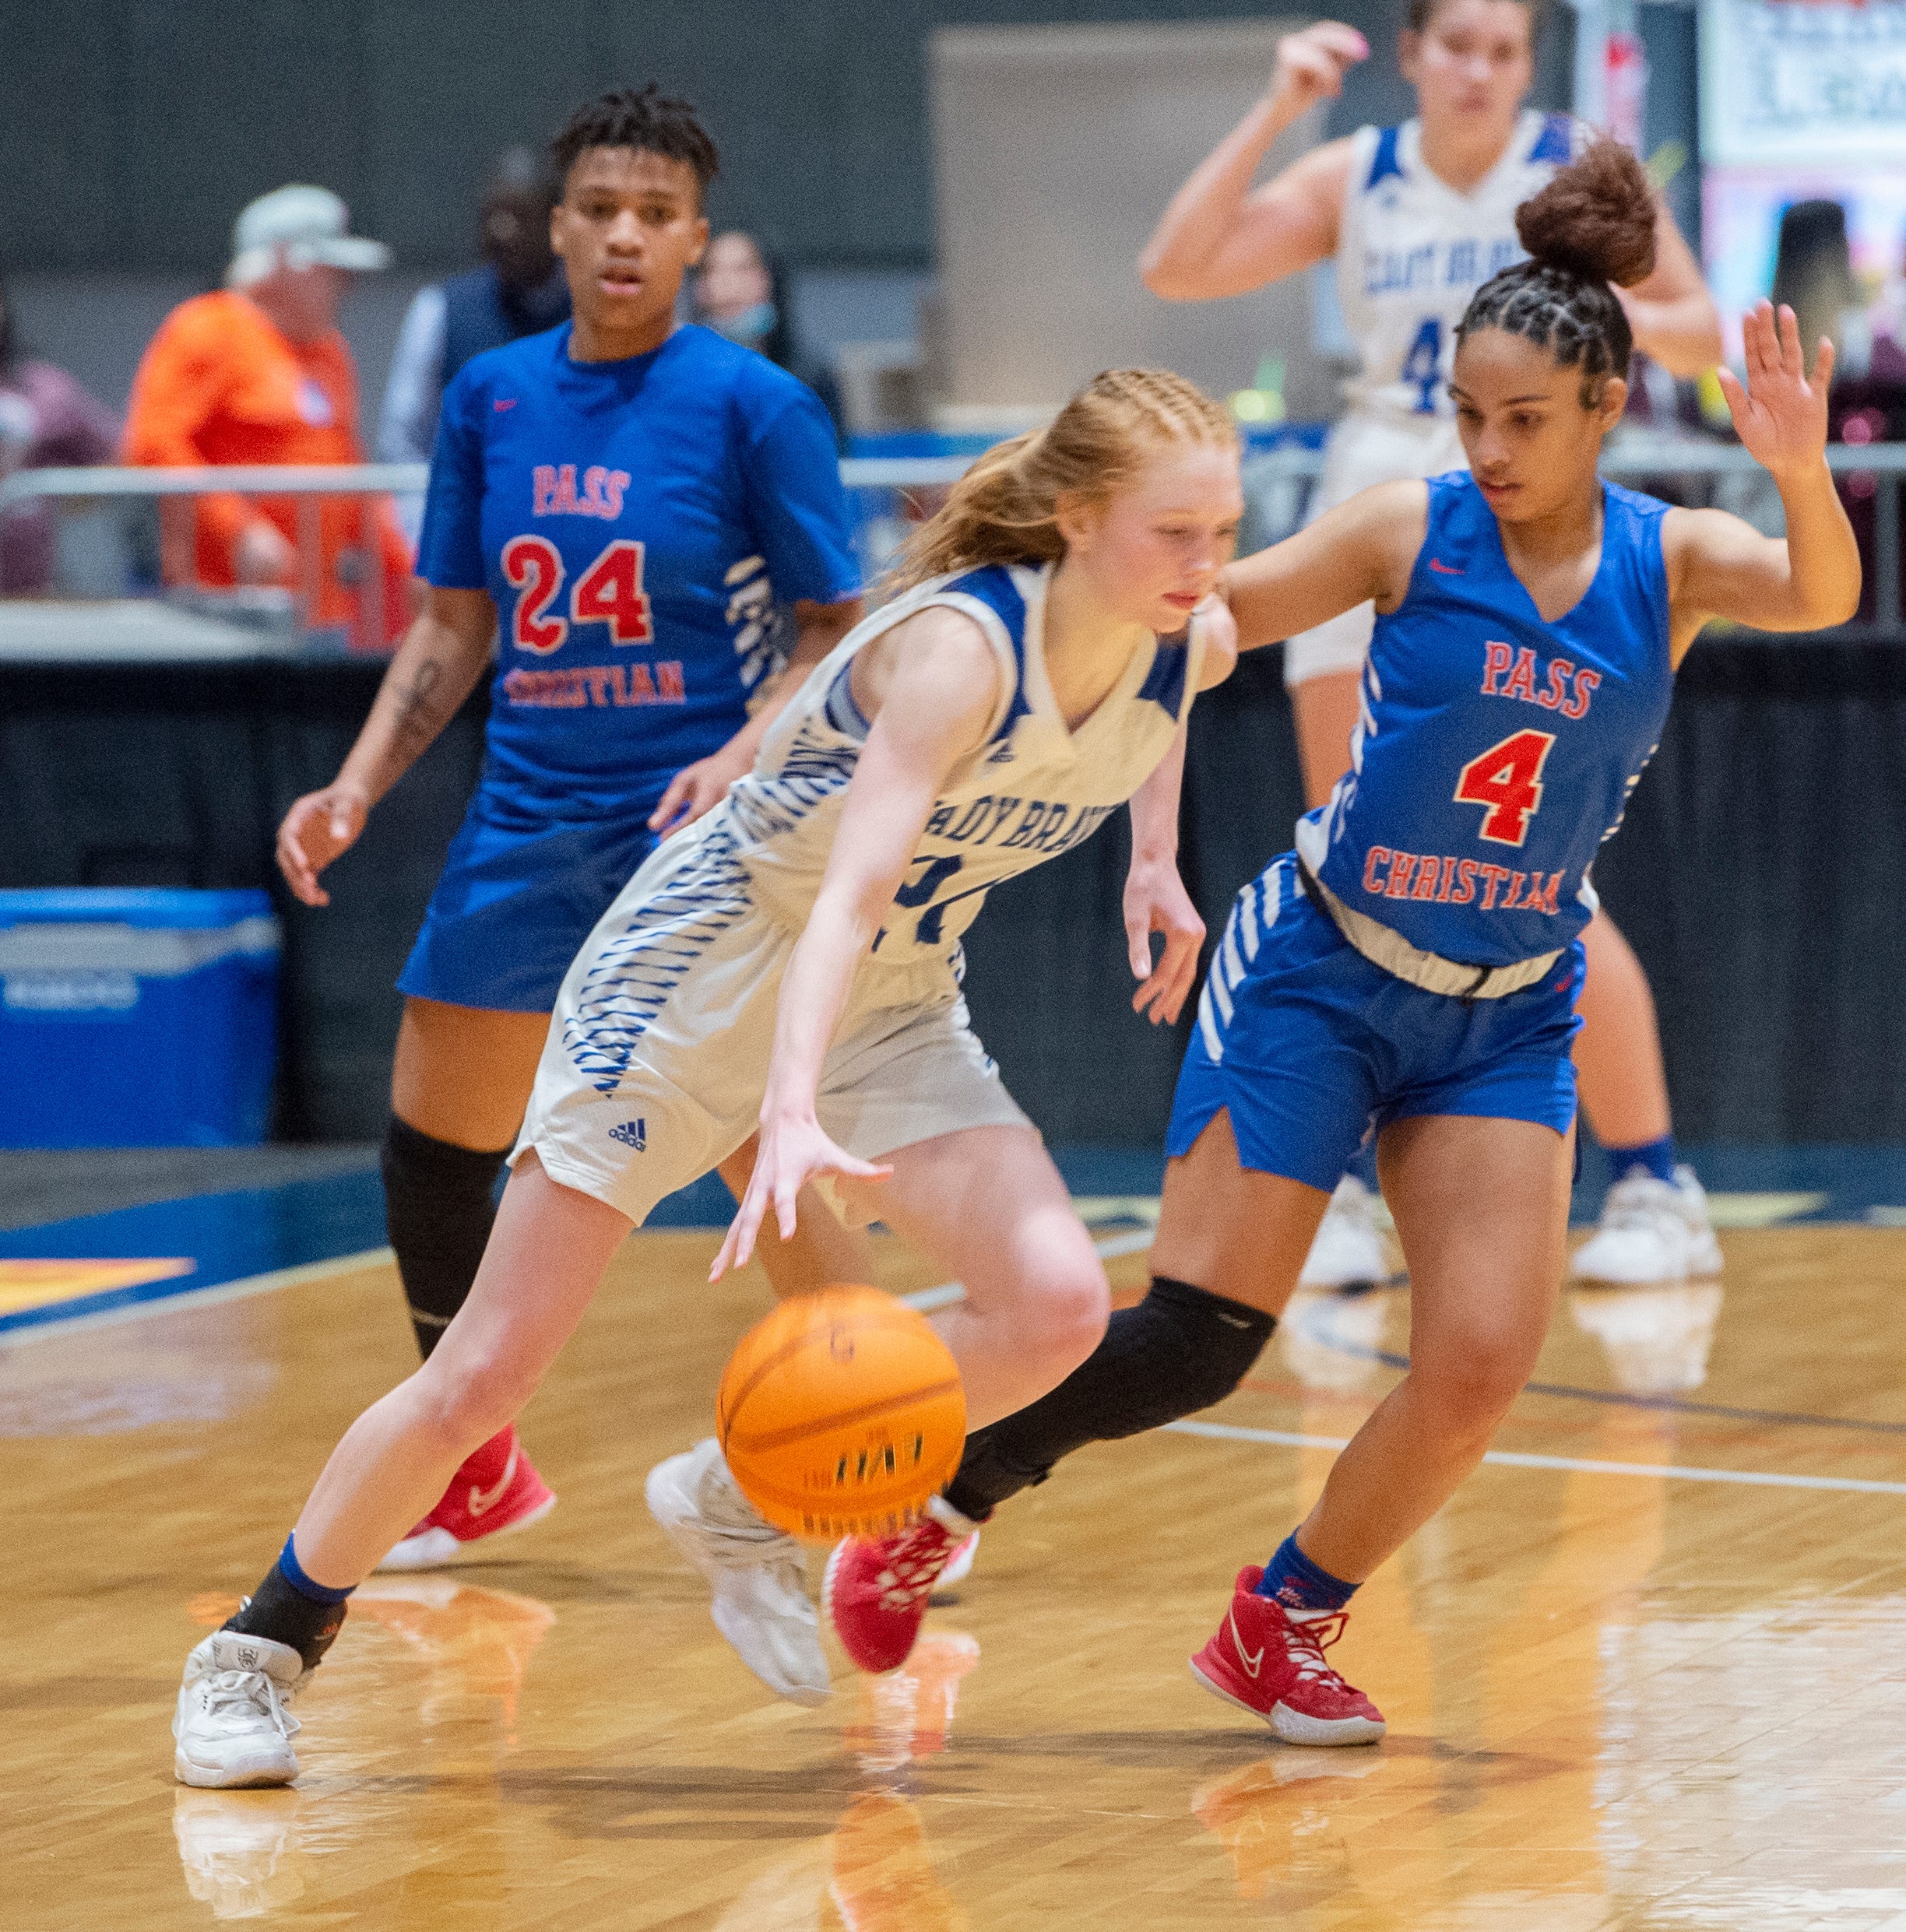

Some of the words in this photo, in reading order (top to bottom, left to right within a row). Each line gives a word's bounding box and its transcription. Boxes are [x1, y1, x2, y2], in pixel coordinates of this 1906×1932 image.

[533, 463, 631, 521] PASS
[501, 534, 654, 655] 24
[1481, 641, 1602, 720] PASS
[924, 795, 1022, 845] ADY
[1453, 728, 1556, 848] 4
